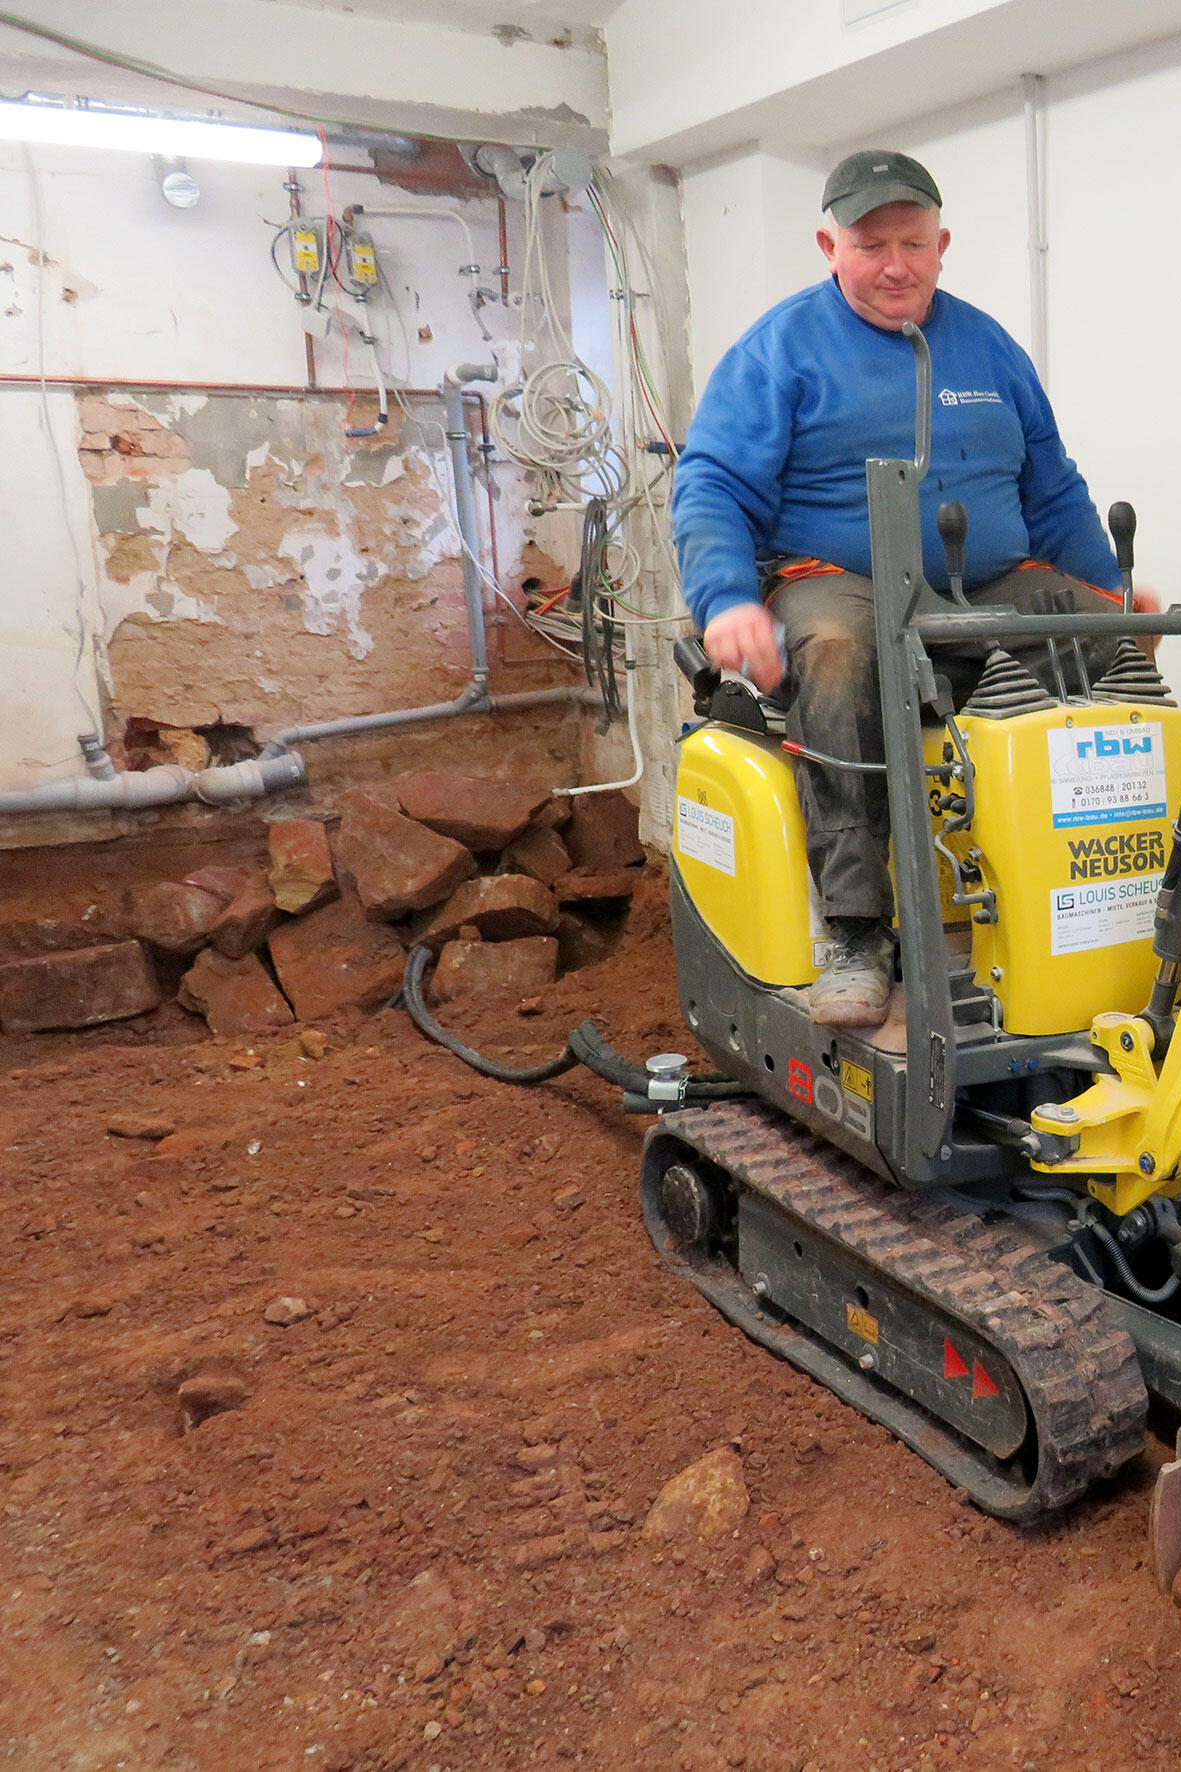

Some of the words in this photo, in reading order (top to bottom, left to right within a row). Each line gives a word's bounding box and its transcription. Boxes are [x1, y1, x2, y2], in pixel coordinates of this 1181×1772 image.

[1077, 731, 1152, 758] rbw
[1085, 784, 1115, 795] 036848
[1122, 781, 1147, 791] 20132
[1081, 797, 1100, 807] 0170
[1107, 795, 1117, 804] 93
[1120, 794, 1129, 803] 88
[1132, 793, 1142, 802] 66
[1067, 831, 1164, 859] WACKER
[1070, 850, 1165, 880] NEUSON
[1079, 887, 1116, 905] LOUIS
